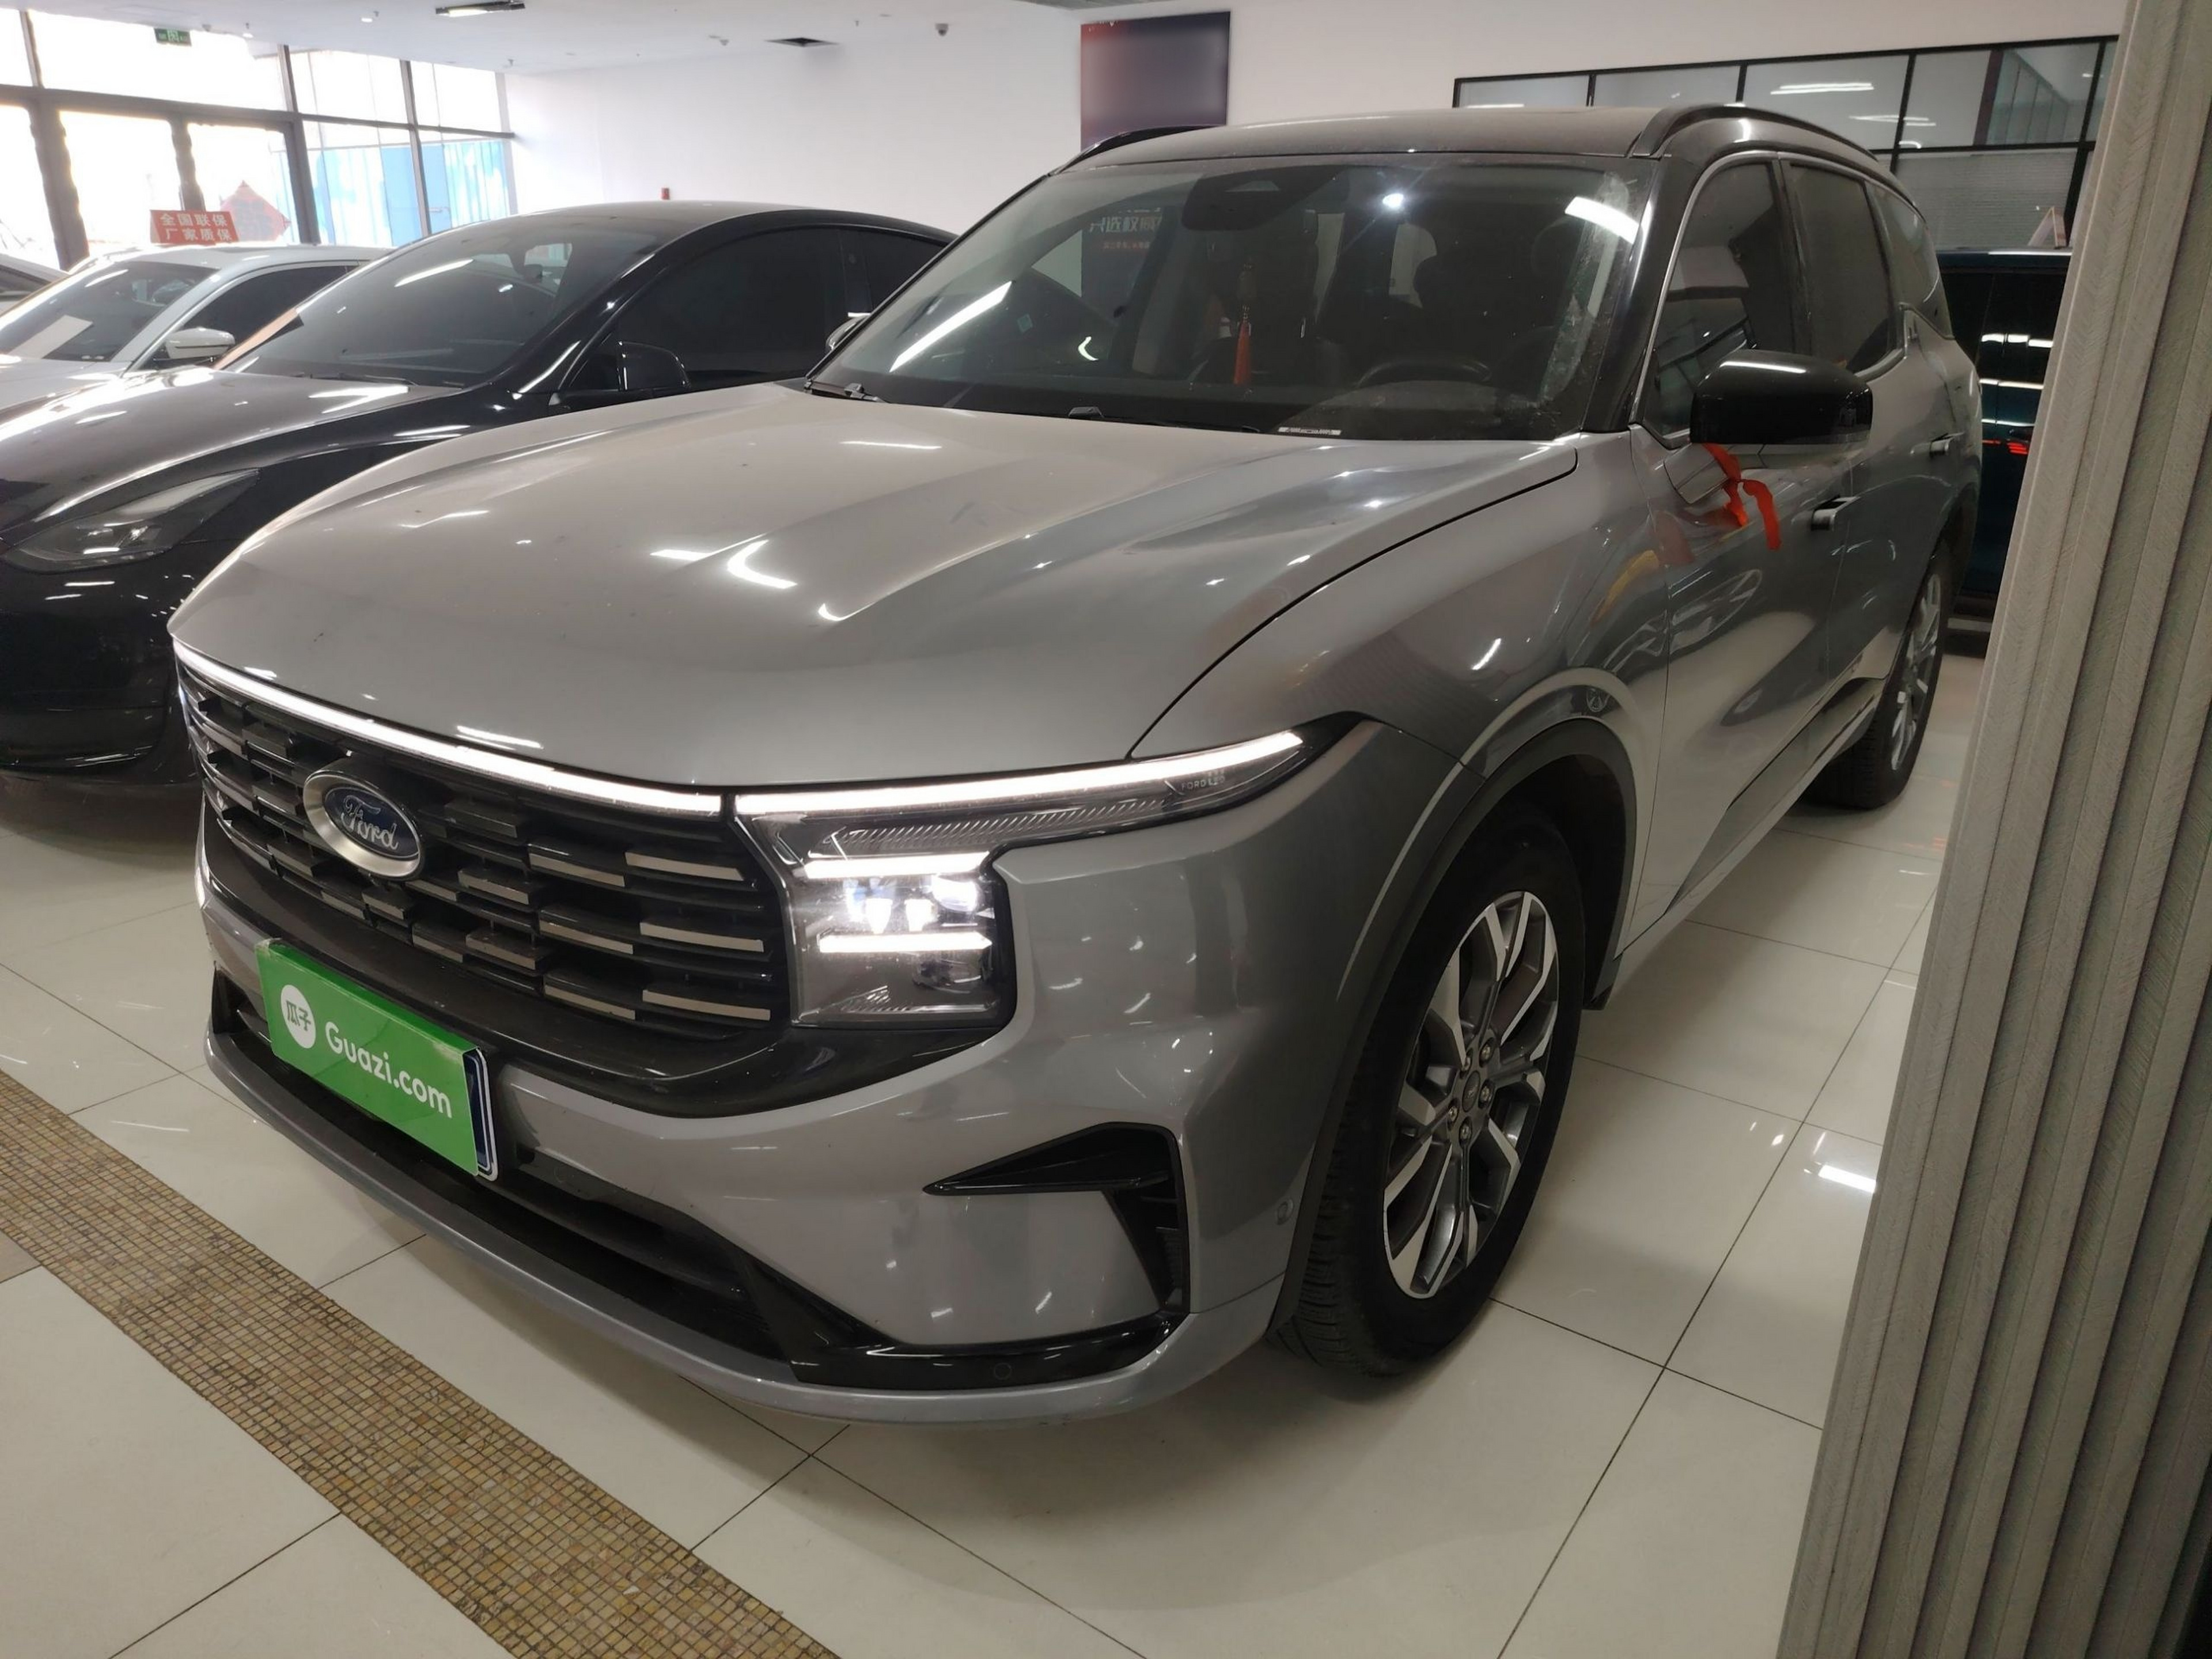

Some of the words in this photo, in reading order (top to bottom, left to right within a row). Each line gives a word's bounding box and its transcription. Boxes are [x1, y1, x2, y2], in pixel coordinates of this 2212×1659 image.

[160, 213, 228, 226] 全国联保
[165, 228, 232, 241] 厂家质保
[1181, 779, 1207, 791] FORD
[340, 794, 399, 850] Ford
[286, 999, 311, 1032] 瓜子
[324, 1021, 452, 1119] Guazi.com
